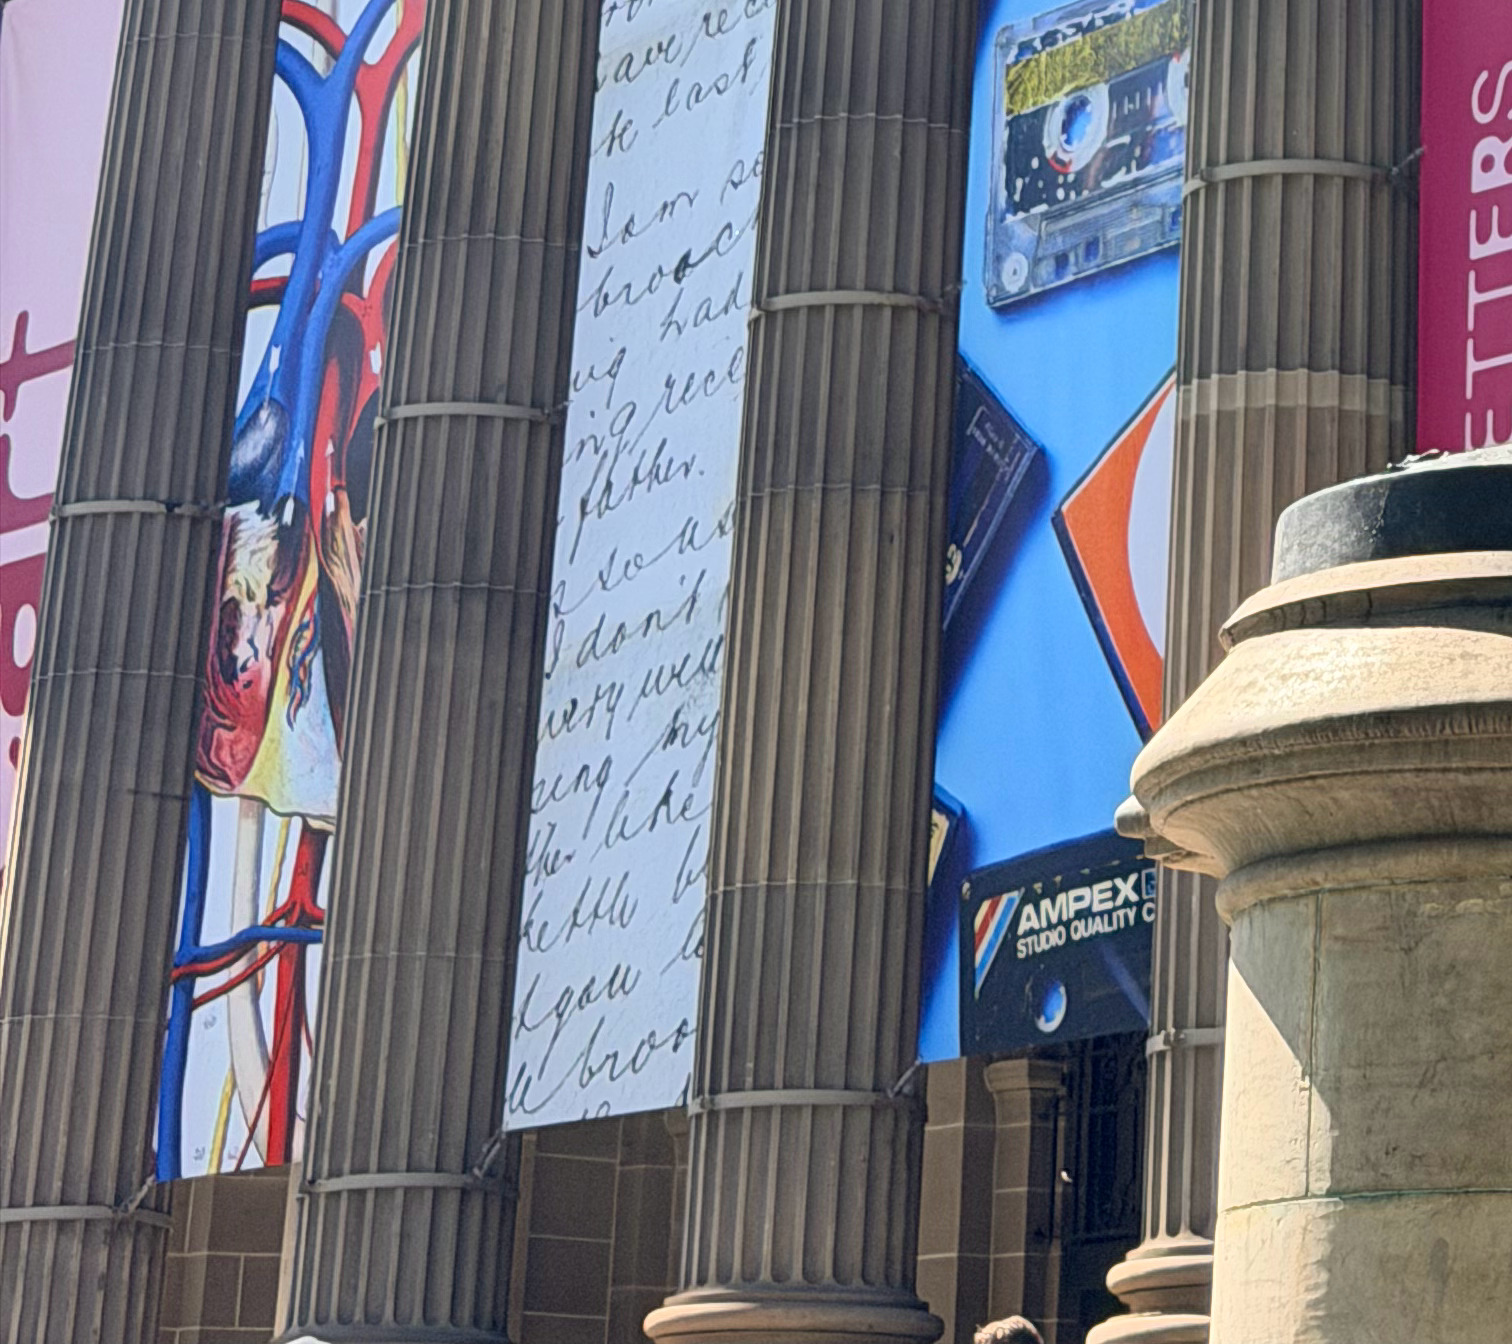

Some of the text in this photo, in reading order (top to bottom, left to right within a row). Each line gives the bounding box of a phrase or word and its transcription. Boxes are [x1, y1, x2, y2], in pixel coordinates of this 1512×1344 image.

[1016, 925, 1067, 959] STUDIO
[1070, 906, 1137, 941] QUALITY
[1017, 872, 1140, 936] AMPEX
